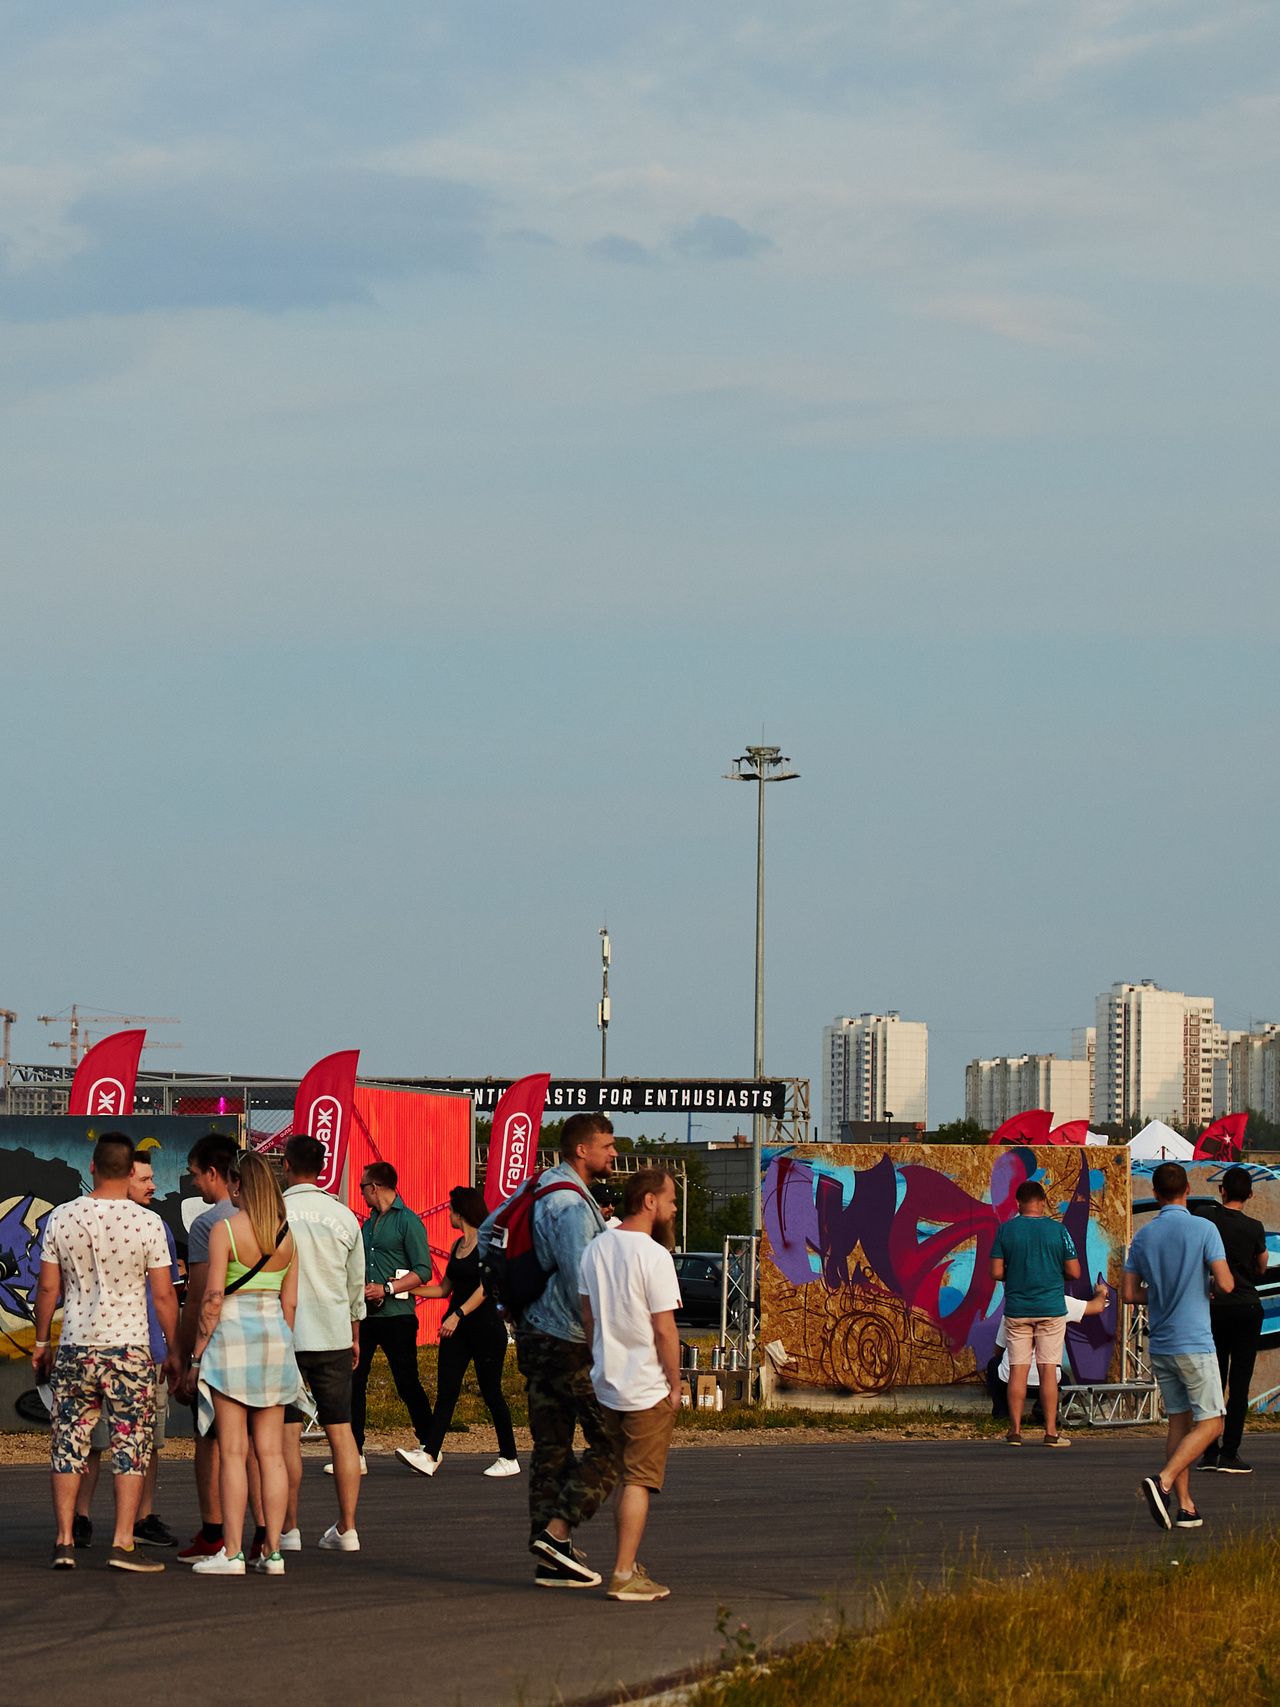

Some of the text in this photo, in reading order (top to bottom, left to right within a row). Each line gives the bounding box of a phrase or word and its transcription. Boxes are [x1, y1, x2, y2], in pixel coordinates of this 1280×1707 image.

[599, 1088, 632, 1106] FOR
[644, 1088, 773, 1107] ENTHUSIASTS
[506, 1122, 527, 1189] гараж
[287, 1209, 351, 1240] Angeles
